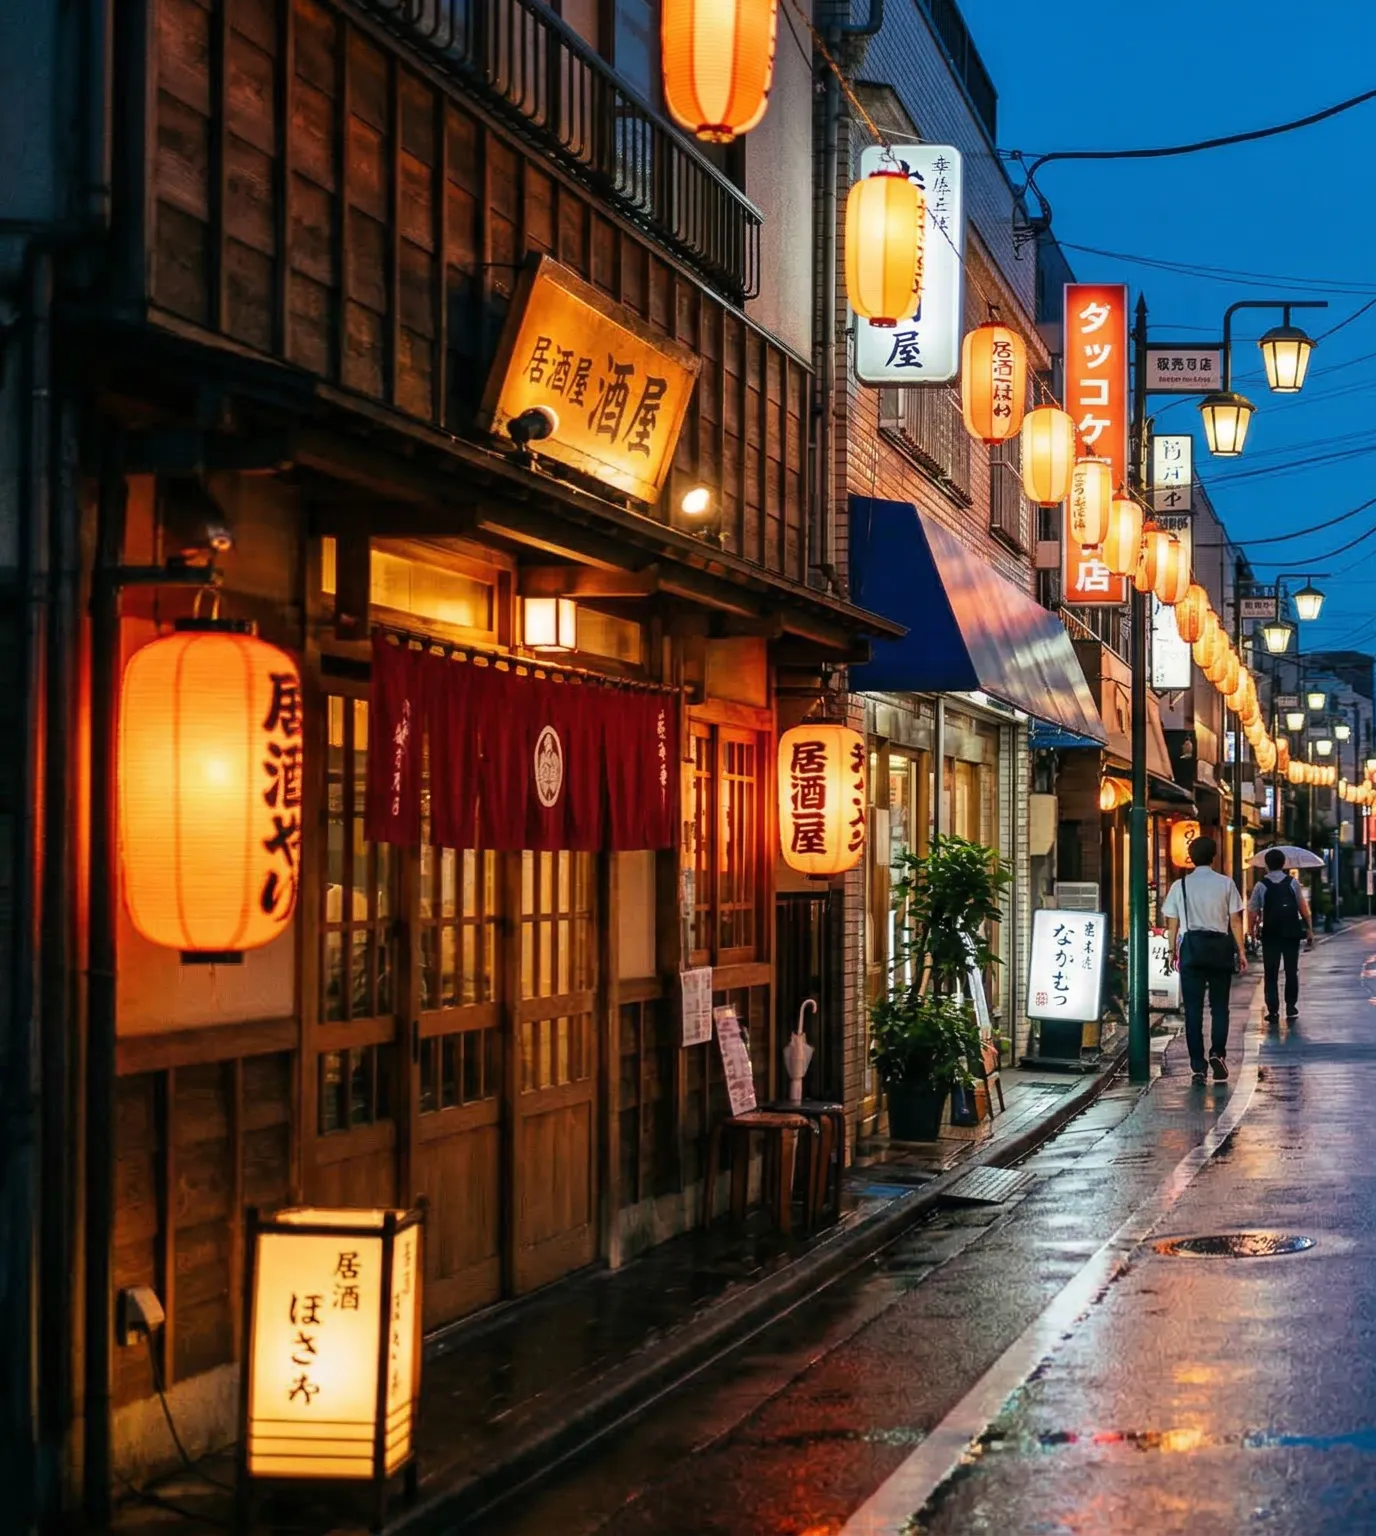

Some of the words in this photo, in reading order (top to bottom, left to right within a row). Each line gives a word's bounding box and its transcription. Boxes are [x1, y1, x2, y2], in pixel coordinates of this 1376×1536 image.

[523, 336, 593, 407] 居酒屋
[587, 352, 668, 459] 酒屋
